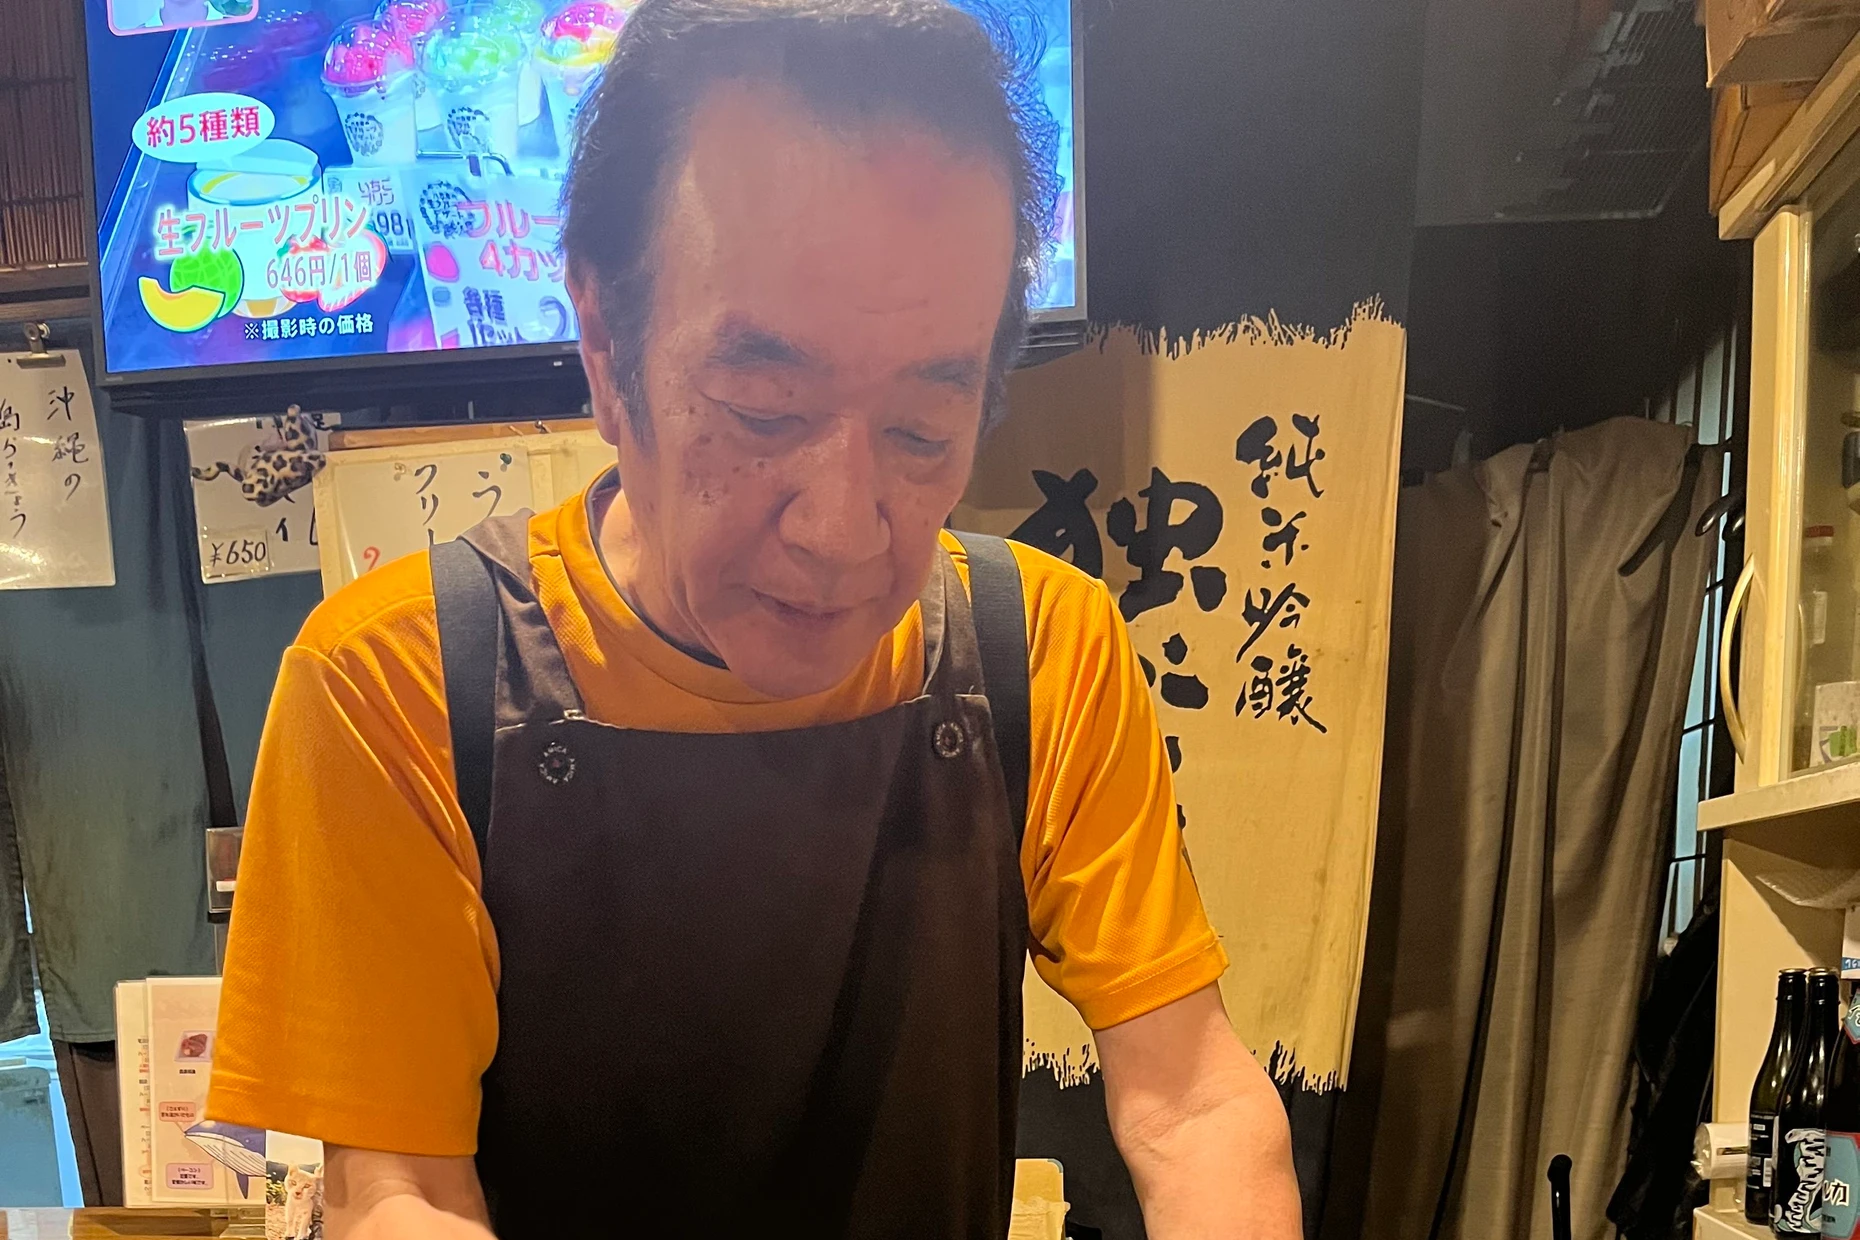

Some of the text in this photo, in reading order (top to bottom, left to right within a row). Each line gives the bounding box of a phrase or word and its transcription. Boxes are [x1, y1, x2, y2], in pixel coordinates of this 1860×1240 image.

[146, 105, 262, 148] 約5種類
[156, 195, 367, 257] 生フルーツプリン
[266, 252, 373, 289] 646円/1個
[47, 386, 89, 500] 沖縄の
[210, 539, 267, 567] ¥650
